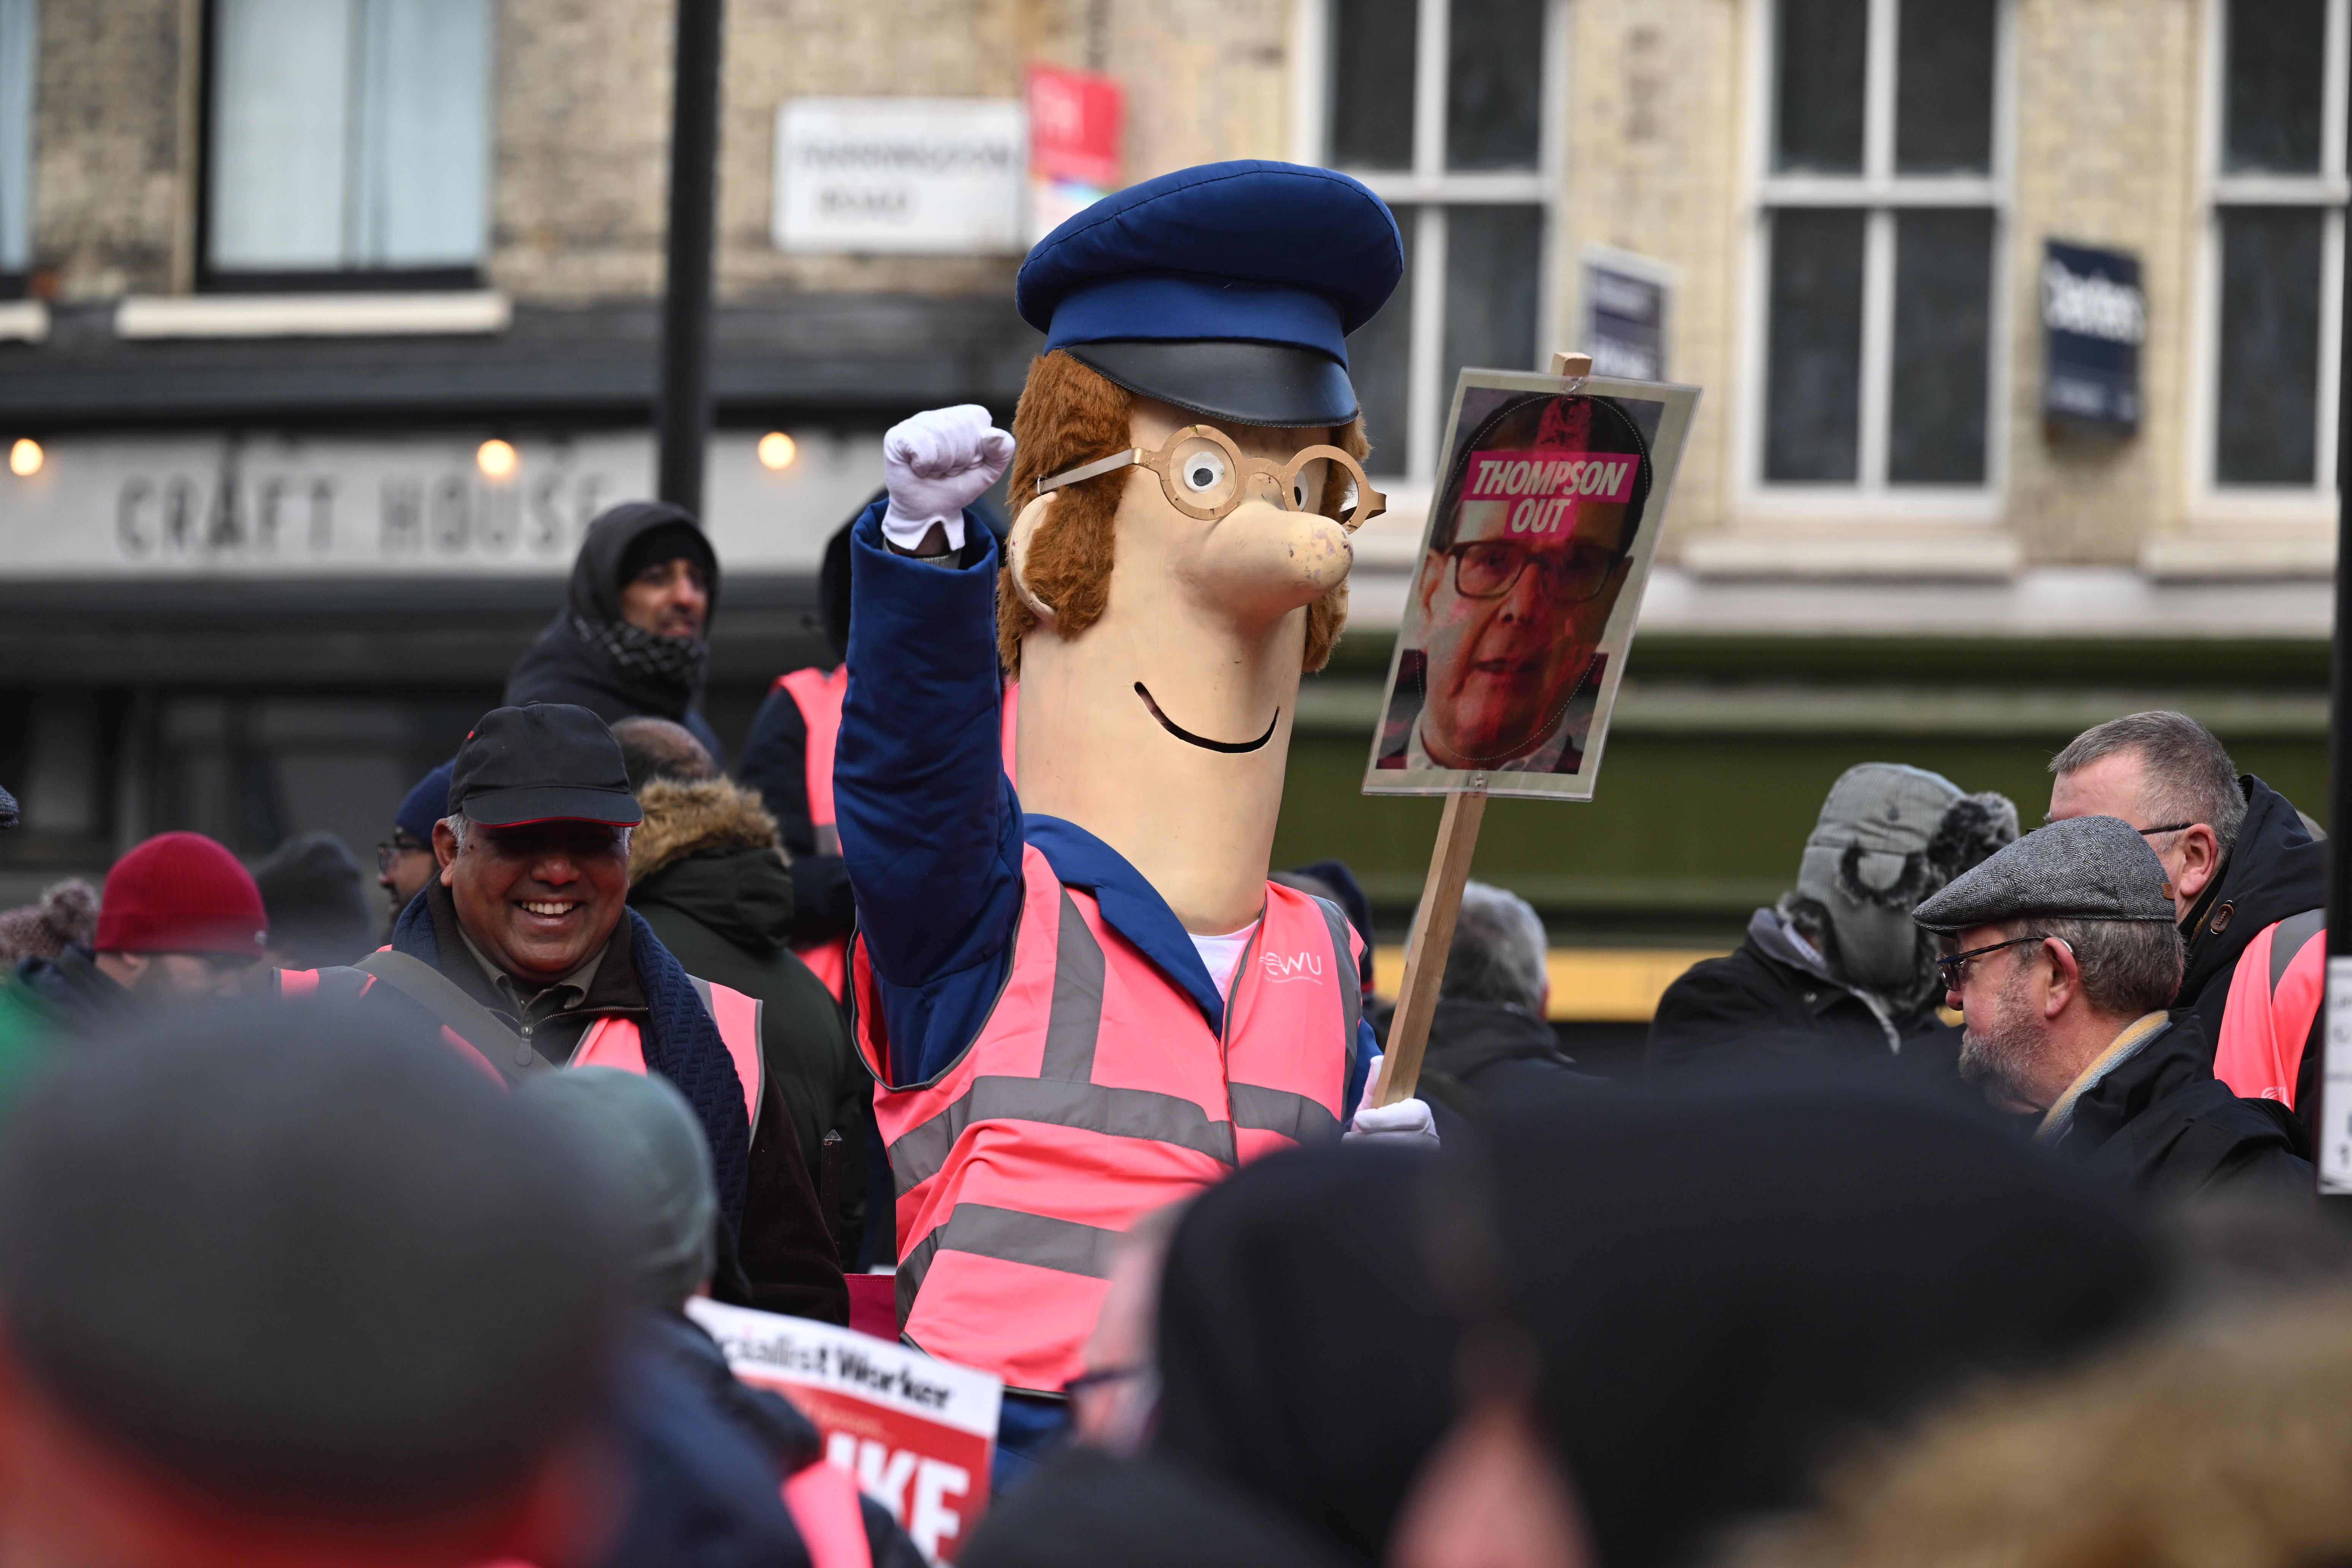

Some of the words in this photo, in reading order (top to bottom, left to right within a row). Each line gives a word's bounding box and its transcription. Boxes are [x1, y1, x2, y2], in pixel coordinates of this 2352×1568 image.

[1473, 460, 1628, 496] THOMPSON
[116, 474, 340, 558] CRAFT
[1511, 498, 1572, 533] OUT
[1271, 975, 1312, 983] communications
[719, 1329, 830, 1377] cialist
[837, 1347, 952, 1408] Worker
